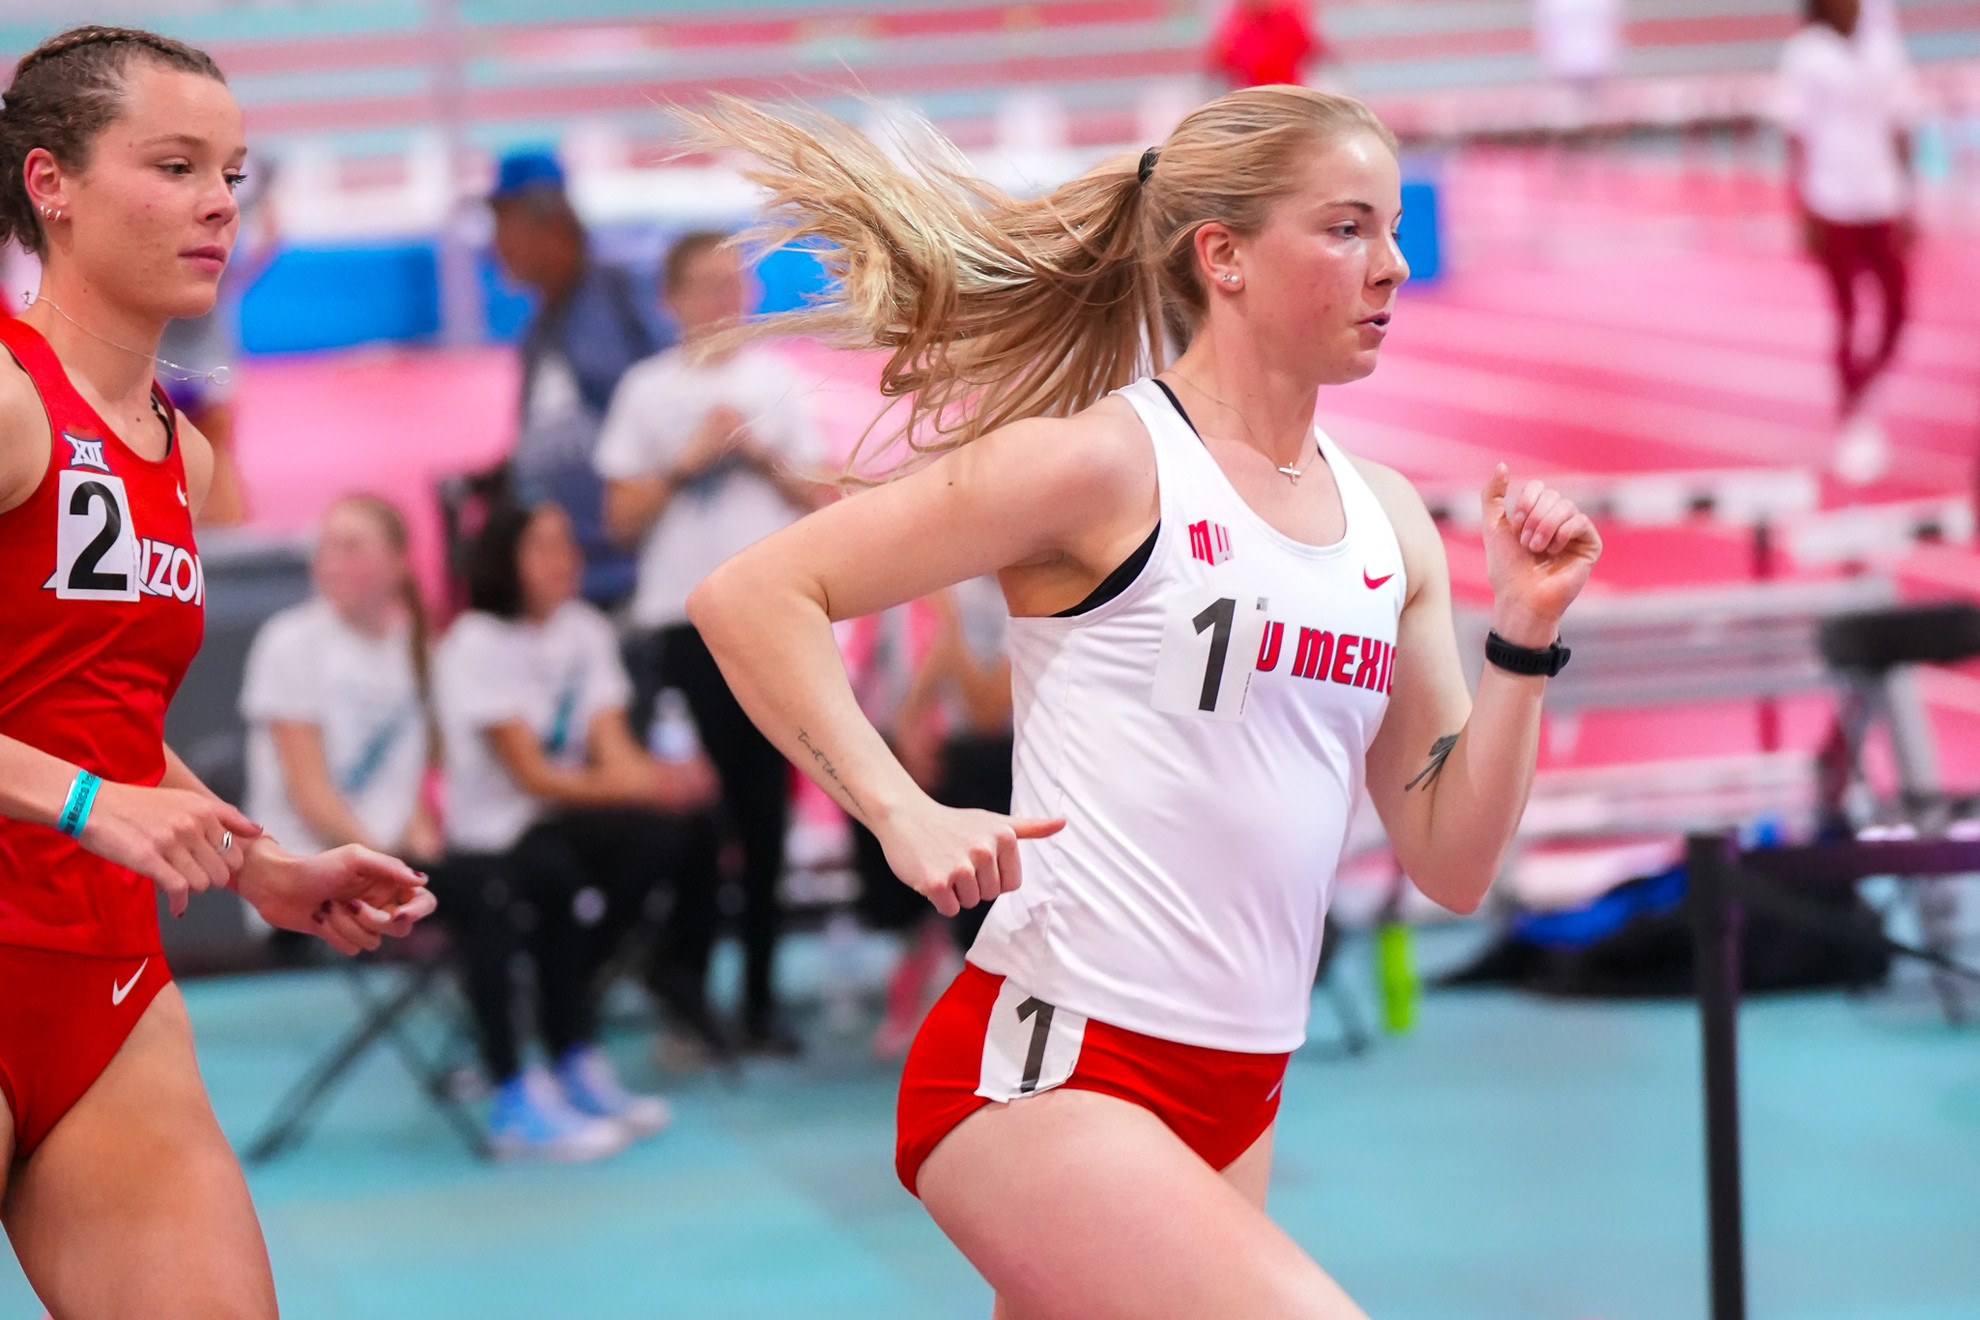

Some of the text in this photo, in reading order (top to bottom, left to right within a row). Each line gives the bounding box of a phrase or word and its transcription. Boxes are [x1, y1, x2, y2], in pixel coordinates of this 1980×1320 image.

[61, 431, 112, 473] XII
[67, 480, 128, 591] 2
[1192, 597, 1237, 712] 1
[1290, 626, 1396, 696] MEXI
[1015, 995, 1056, 1094] 1
